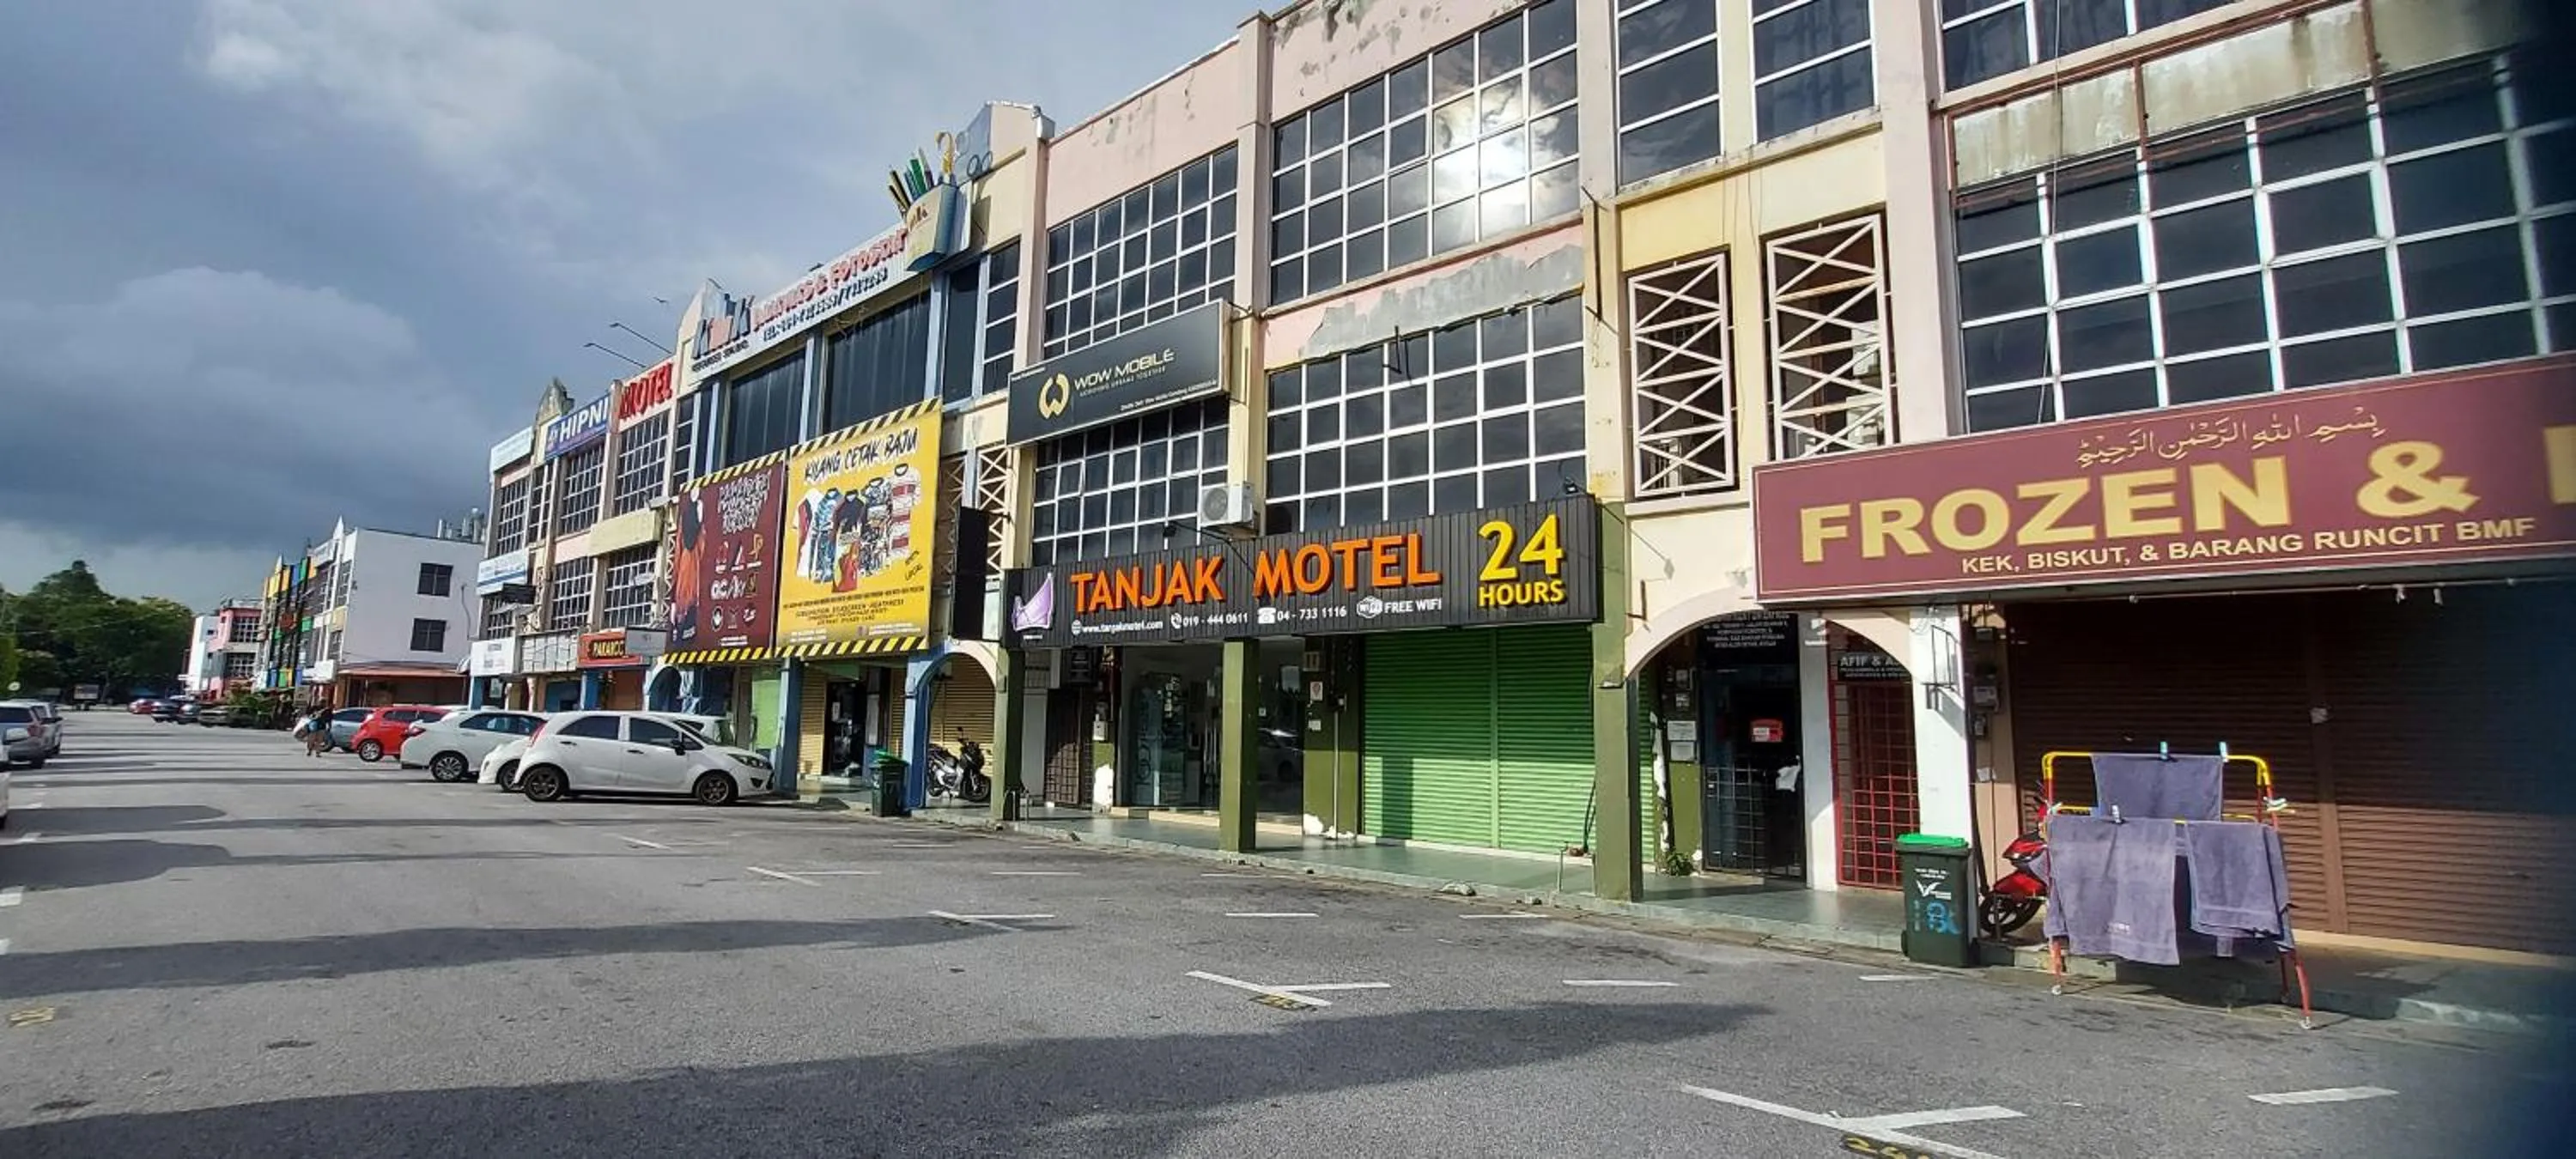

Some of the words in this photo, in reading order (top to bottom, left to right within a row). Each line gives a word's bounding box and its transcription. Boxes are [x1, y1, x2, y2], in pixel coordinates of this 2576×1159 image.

[1074, 368, 1112, 391] WOW
[1115, 348, 1175, 378] MOBILE
[844, 439, 880, 470] CETAK
[884, 428, 918, 458] BAJU
[1800, 455, 2292, 563] FROZEN
[2357, 440, 2480, 518] &
[1477, 513, 1565, 583] 24
[1962, 555, 2020, 574] KEK,
[2027, 546, 2130, 571] BISKUT,
[2140, 544, 2160, 561] &
[2168, 533, 2303, 560] BARANG
[2314, 524, 2445, 549] RUNCIT
[2456, 517, 2537, 542] BMF
[1071, 554, 1225, 615] TANJAK
[1252, 531, 1443, 600] MOTEL
[1478, 579, 1566, 609] HOURS
[1182, 616, 1199, 628] 019
[1207, 614, 1224, 626] 444
[1225, 612, 1249, 623] 0611
[1277, 610, 1290, 622] 04
[1299, 608, 1318, 621] 733
[1321, 606, 1347, 618] 1116
[1384, 600, 1413, 614] FREE
[1416, 598, 1442, 611] WIFI
